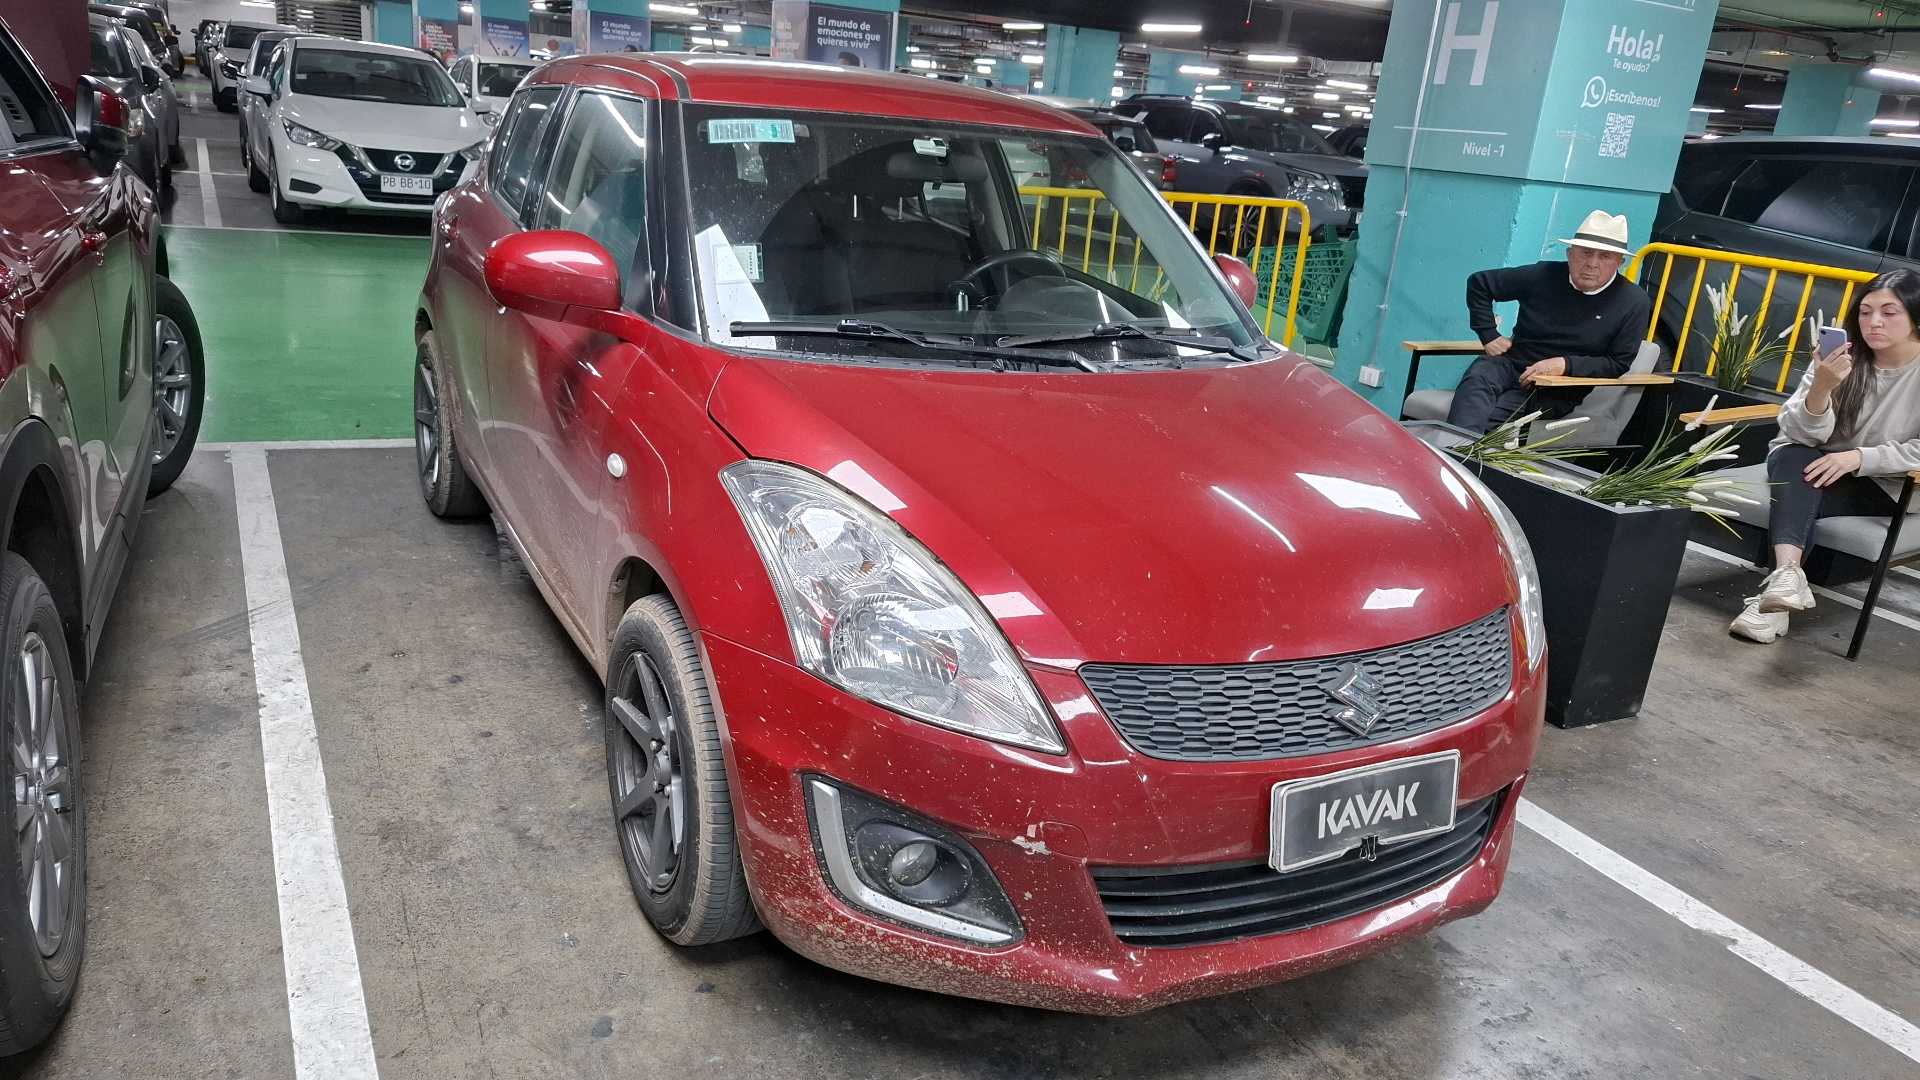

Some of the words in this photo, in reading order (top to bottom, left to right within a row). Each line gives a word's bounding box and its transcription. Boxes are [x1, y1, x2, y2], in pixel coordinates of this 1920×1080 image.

[817, 16, 827, 26] El
[828, 18, 859, 30] mundo
[860, 21, 871, 31] de
[817, 27, 863, 40] emociones
[864, 33, 881, 42] que
[817, 36, 849, 48] quieres
[1434, 2, 1499, 86] H
[1606, 25, 1664, 63] Hola!
[1613, 58, 1622, 69] Te
[1622, 60, 1651, 73] ayudo?
[1462, 141, 1492, 158] Nivel
[1492, 143, 1506, 159] -1
[1317, 781, 1422, 840] KAVAK
